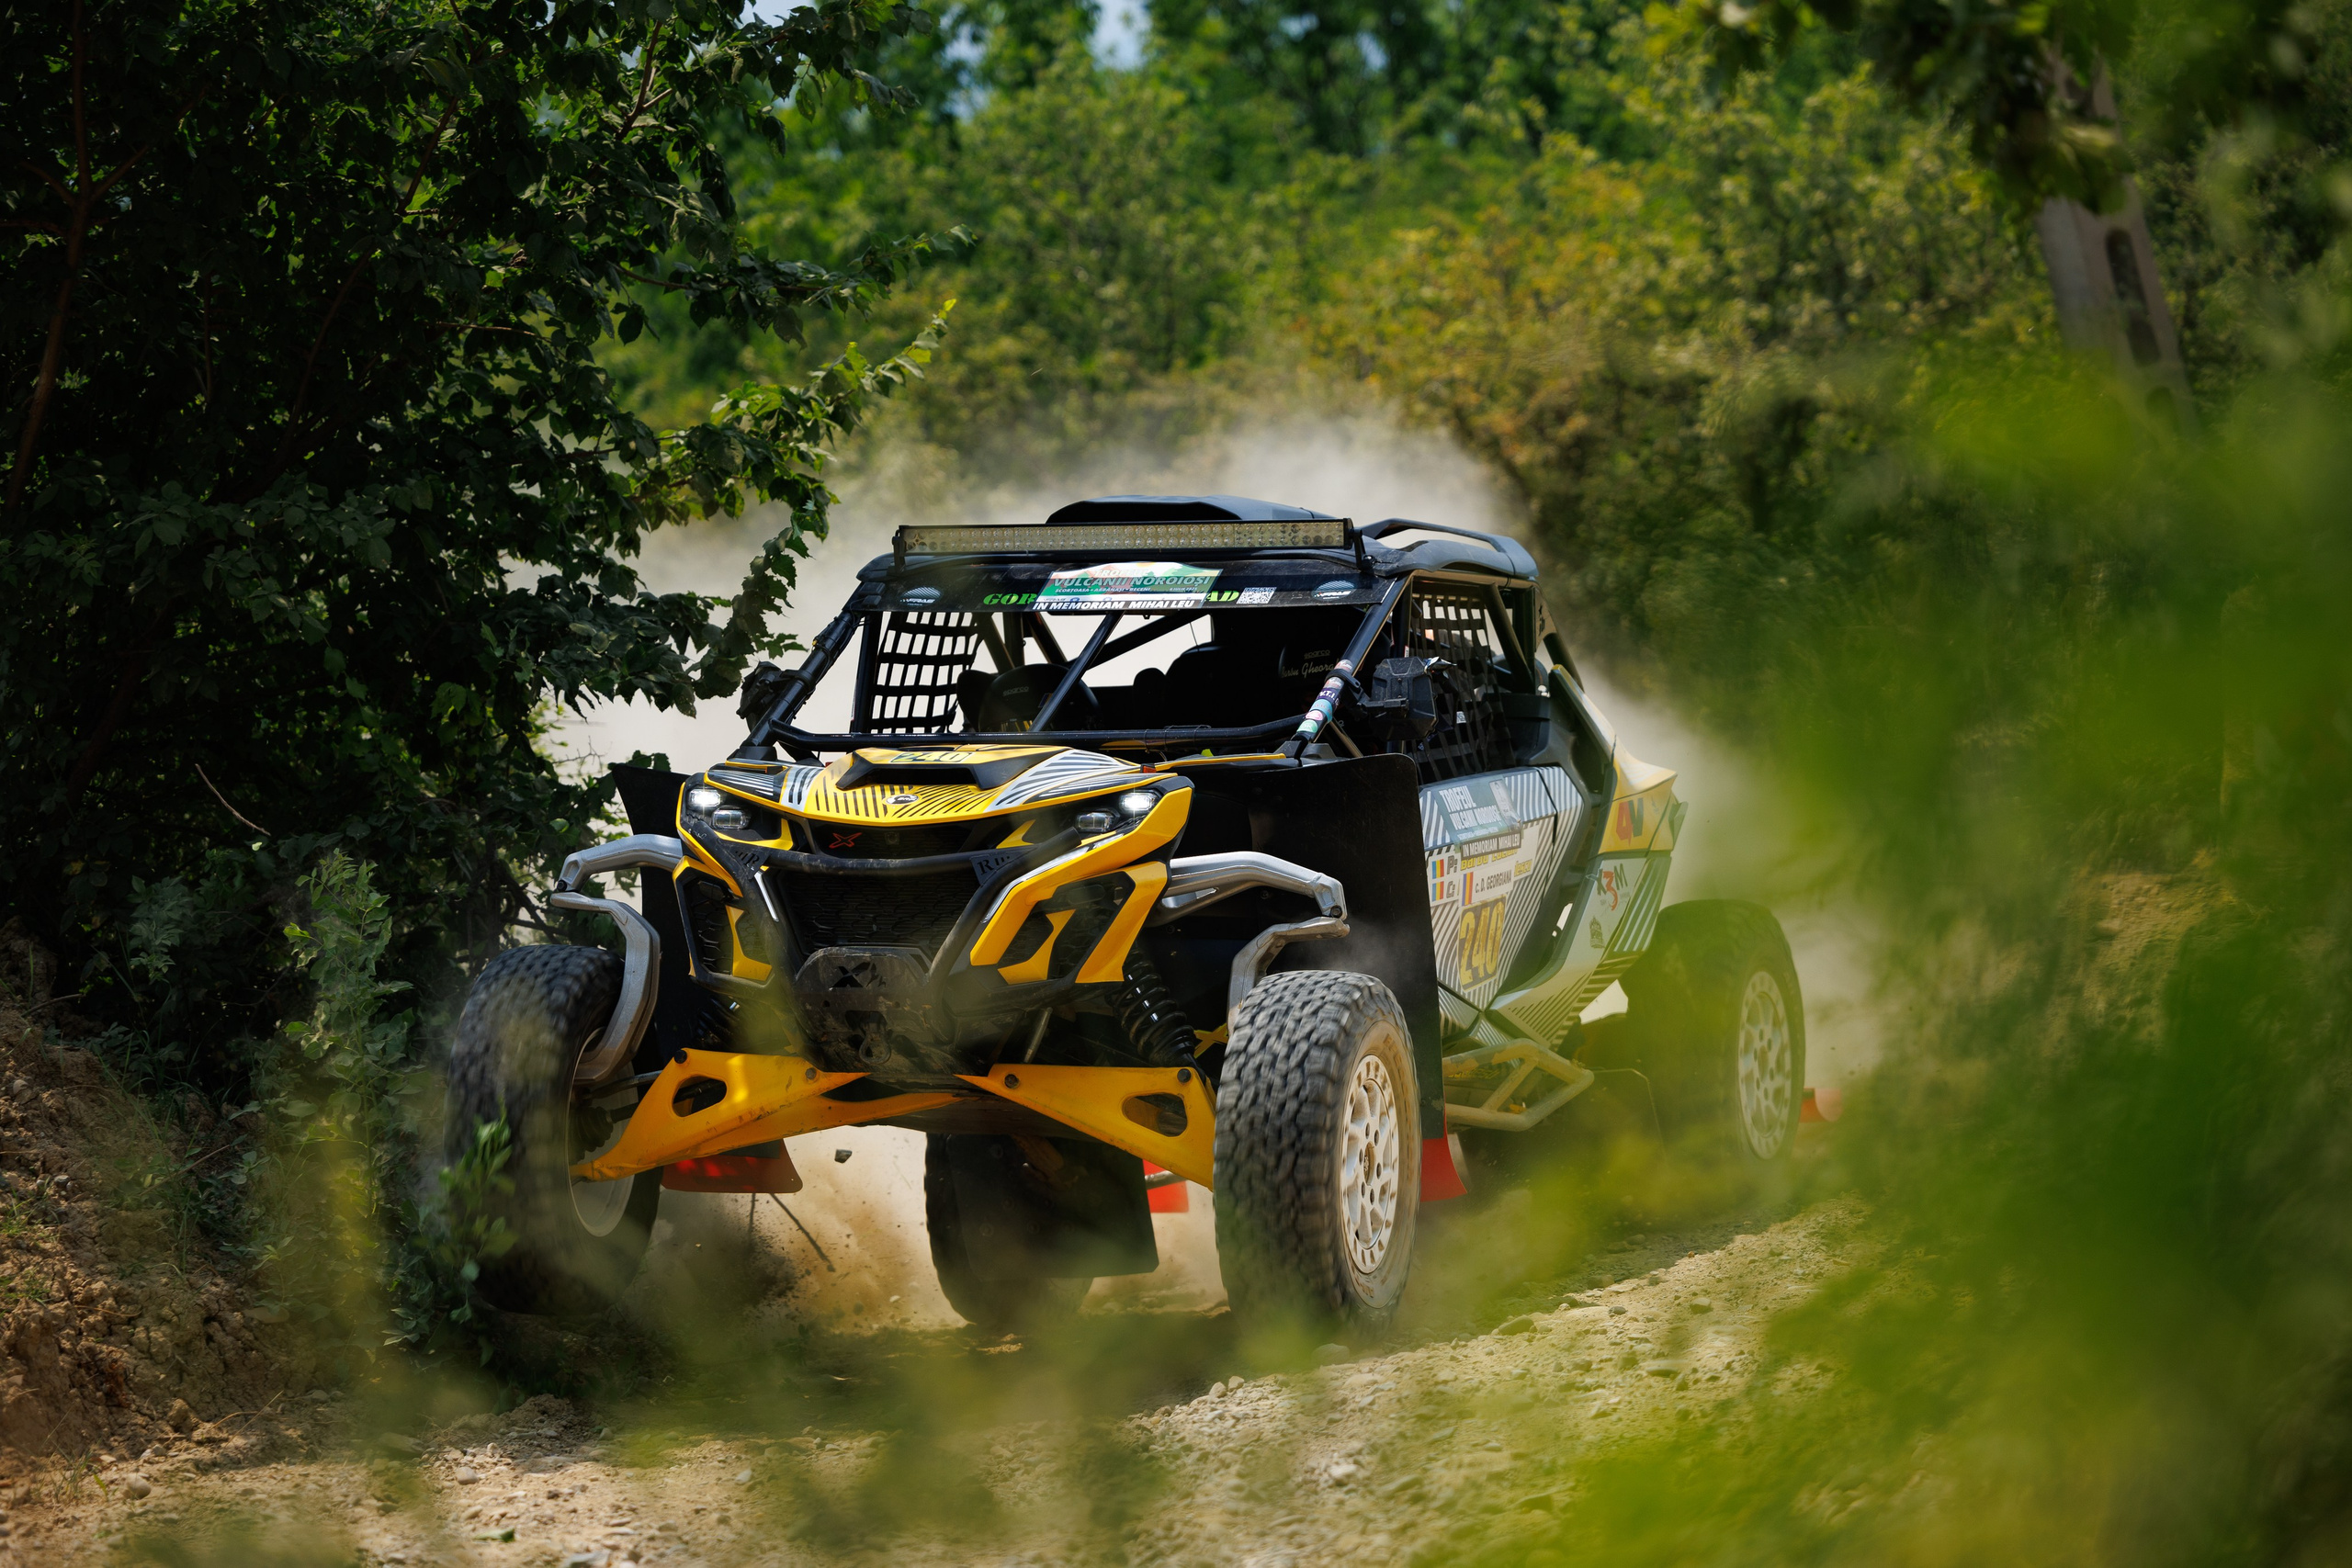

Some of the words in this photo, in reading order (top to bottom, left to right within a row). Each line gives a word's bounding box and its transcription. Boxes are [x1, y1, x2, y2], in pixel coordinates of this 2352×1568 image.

[1053, 577, 1128, 587] VULCANII
[1033, 602, 1049, 610] IN
[1049, 601, 1125, 610] MEMORIAM
[1128, 601, 1172, 609] MIHAI
[1172, 600, 1194, 608] LEU
[897, 751, 968, 762] 240
[1439, 785, 1476, 813] TROFEUL
[1463, 844, 1470, 857] IN
[1470, 837, 1498, 856] MEMORIAM
[1487, 869, 1512, 890] GEORGIANA
[1459, 901, 1505, 985] 240
